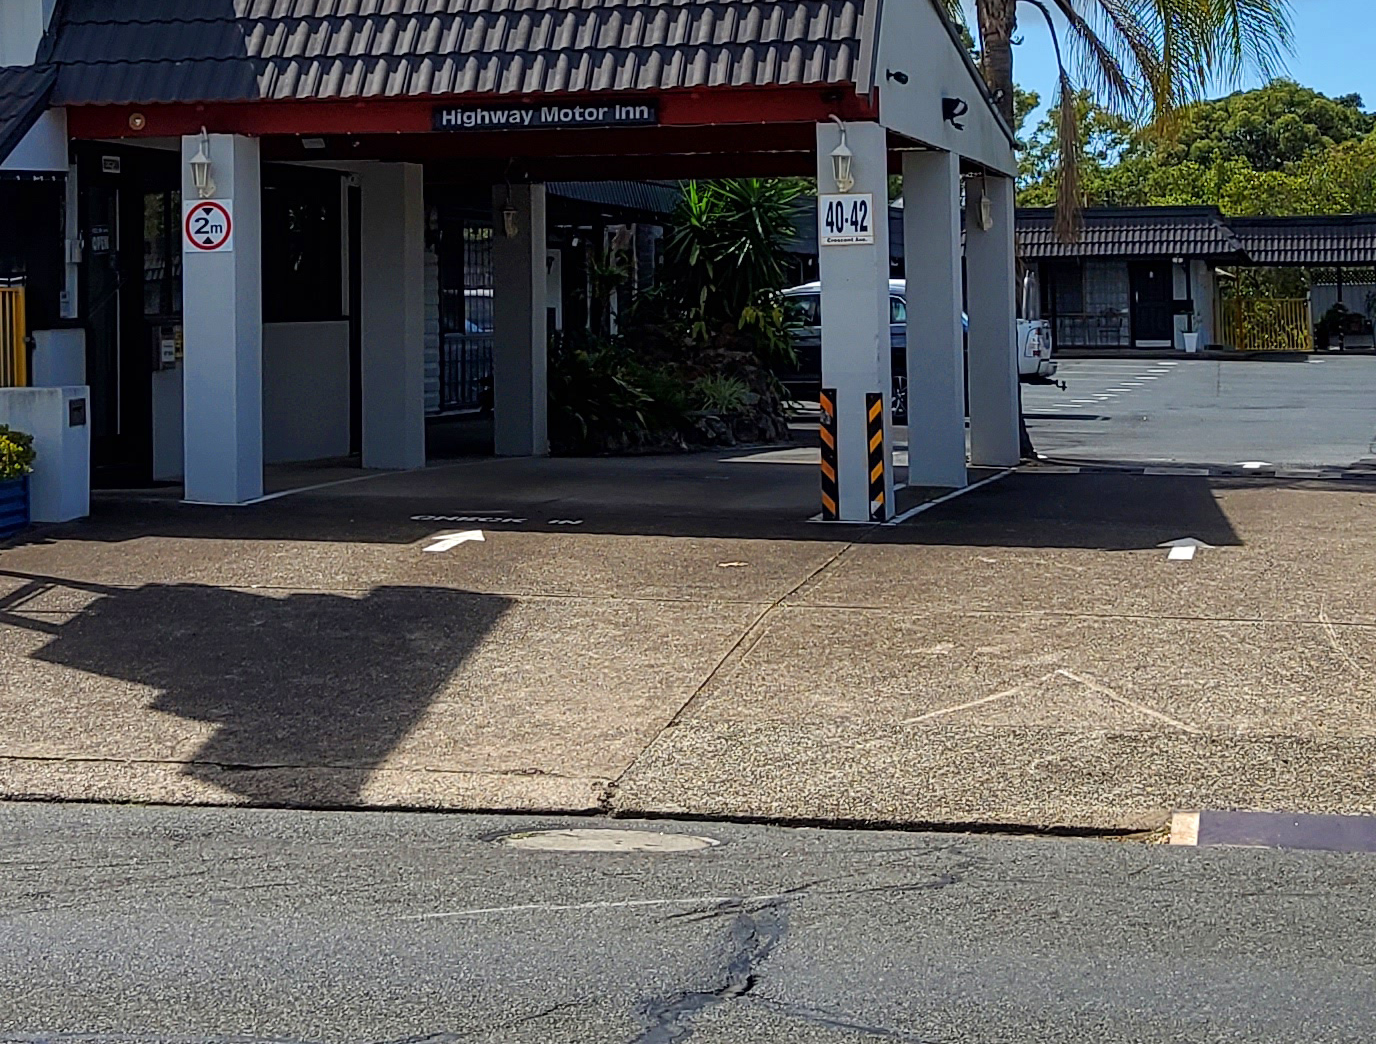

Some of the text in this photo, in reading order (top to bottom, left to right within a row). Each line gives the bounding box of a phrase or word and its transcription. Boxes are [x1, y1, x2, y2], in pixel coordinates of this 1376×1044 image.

[442, 103, 650, 128] Highway Motor Inn
[194, 217, 223, 235] 2m
[826, 200, 869, 233] 40-42
